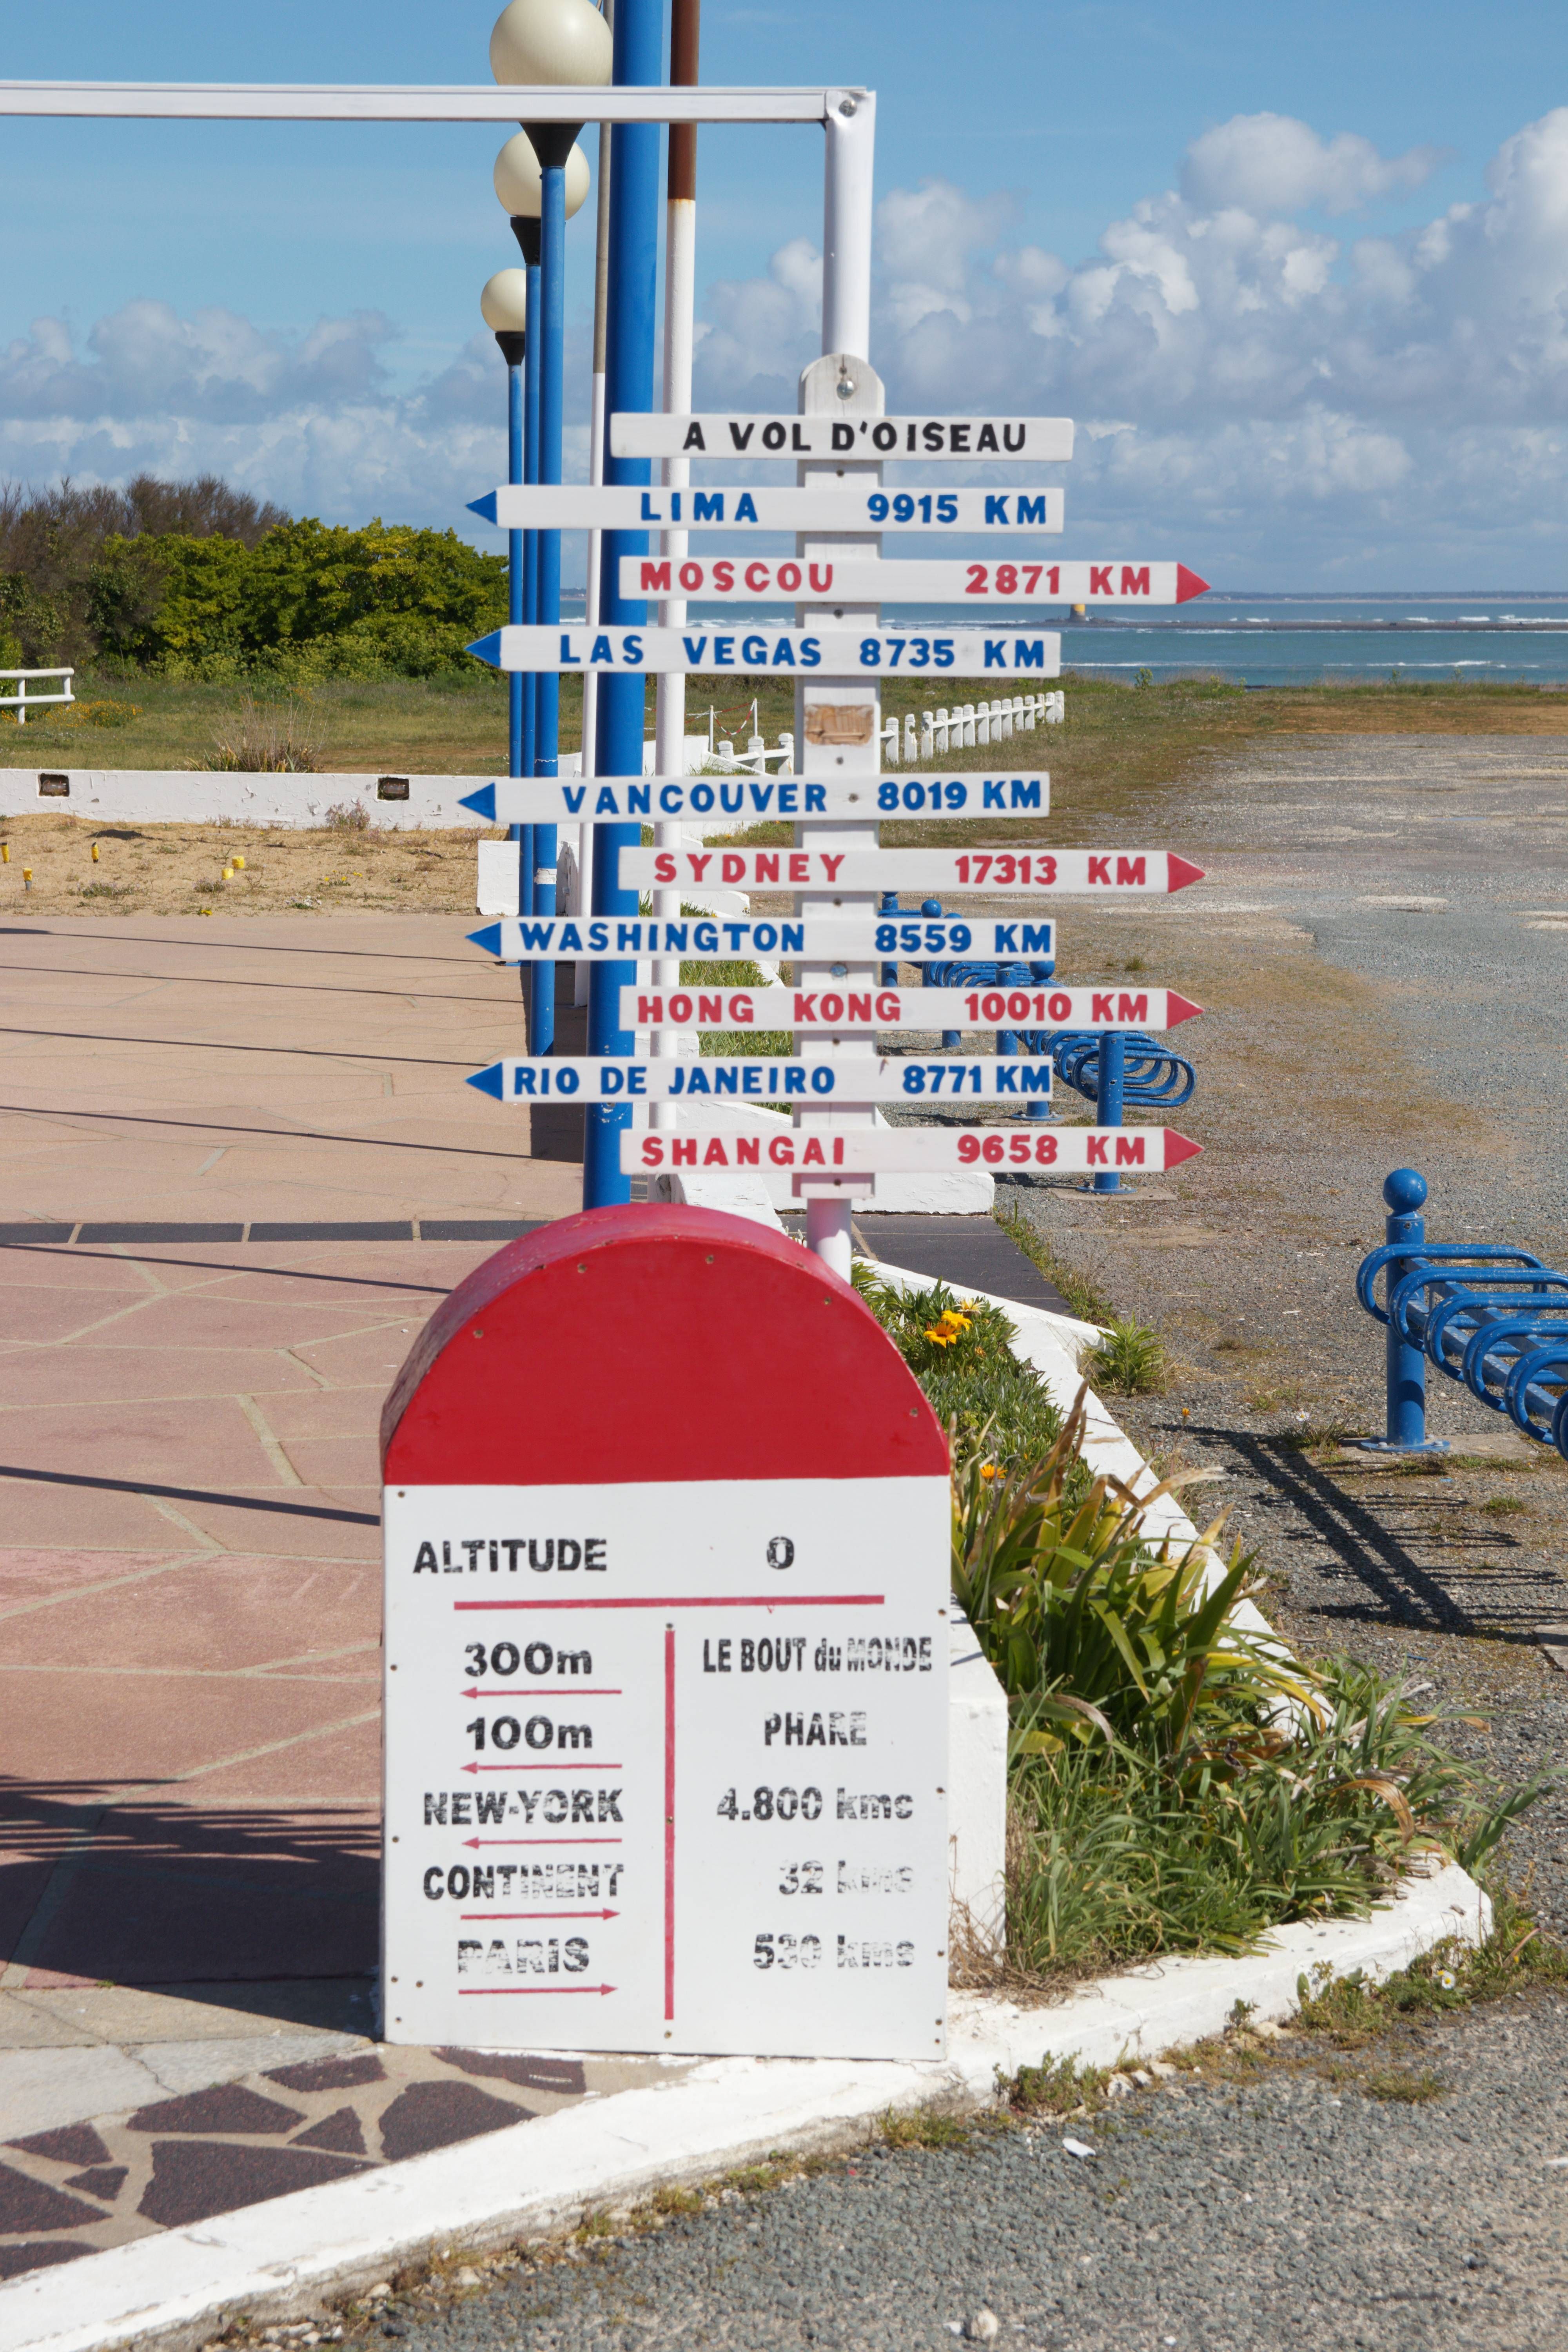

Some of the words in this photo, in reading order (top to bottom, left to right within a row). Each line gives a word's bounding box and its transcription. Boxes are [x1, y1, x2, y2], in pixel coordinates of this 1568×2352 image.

[683, 422, 706, 451] A
[729, 421, 811, 451] VOL
[831, 421, 1025, 452] D'OISEAU
[641, 492, 758, 523] LIMA
[867, 494, 958, 523] 9915
[985, 495, 1046, 524] KM
[641, 561, 833, 593] MOSCOU
[965, 564, 1060, 595] 2871
[1090, 566, 1150, 595] KM
[560, 635, 643, 665] LAS
[682, 635, 821, 667] VEGAS
[860, 638, 955, 667] 8735
[984, 639, 1044, 668] KM
[562, 784, 826, 814] VANCOUVER
[878, 781, 967, 811] 8019
[983, 780, 1041, 809] KM
[654, 853, 845, 884] SYDNEY
[955, 854, 1057, 885] 17313
[1088, 856, 1146, 886] KM
[519, 922, 804, 952] WASHINGTON
[875, 924, 971, 953] 8559
[995, 924, 1051, 953] KM
[638, 994, 754, 1023] HONG
[794, 992, 900, 1022] KONG
[965, 992, 1072, 1022] 10010
[1092, 993, 1148, 1022] KM
[514, 1067, 579, 1095] RIO
[601, 1066, 646, 1094] DE
[668, 1066, 835, 1094] JANEIRO
[903, 1065, 981, 1094] 8771
[996, 1065, 1051, 1093] KM
[641, 1136, 844, 1167] SHANGAI
[957, 1134, 1058, 1165] 9658
[1087, 1136, 1145, 1166] KM
[413, 1538, 607, 1573] ALTITUDE
[766, 1536, 795, 1570] 0
[465, 1642, 592, 1677] 300m
[703, 1639, 731, 1673] LE
[741, 1637, 806, 1672] BOUT
[814, 1638, 841, 1671] du
[848, 1637, 932, 1671] MONDE
[466, 1716, 592, 1750] 100m
[765, 1712, 866, 1746] PHARE
[424, 1789, 623, 1826] NEW-YORK
[717, 1786, 822, 1821] 4.800
[423, 1864, 624, 1900] CONTINENT
[779, 1861, 823, 1895] 32
[458, 1937, 589, 1973] PARIS
[753, 1934, 821, 1969] 530
